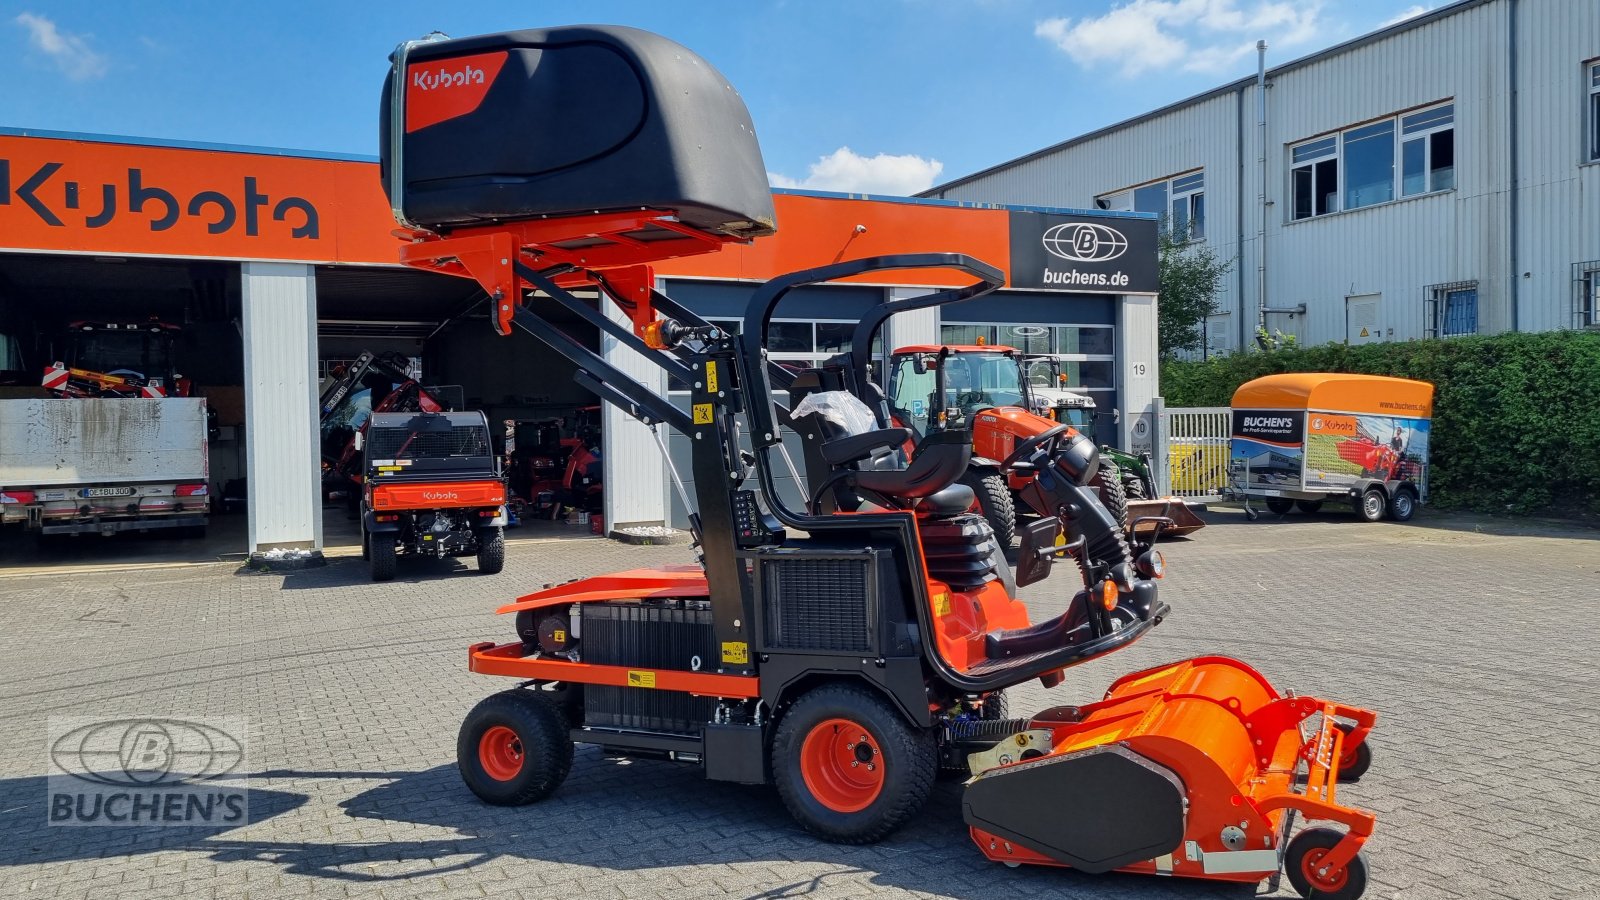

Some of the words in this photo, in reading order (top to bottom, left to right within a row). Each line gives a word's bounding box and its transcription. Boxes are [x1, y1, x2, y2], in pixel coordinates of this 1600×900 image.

[414, 65, 485, 91] Kubota
[0, 159, 320, 240] Kubota
[1043, 268, 1129, 286] buchens.de
[1133, 364, 1146, 375] 19
[1379, 401, 1426, 411] www.buchens.de
[1243, 417, 1293, 427] BUCHEN'S
[1324, 420, 1353, 431] Kubota
[1136, 423, 1145, 433] 10
[104, 488, 114, 496] BU
[115, 487, 129, 496] 300
[423, 492, 458, 500] Kubota
